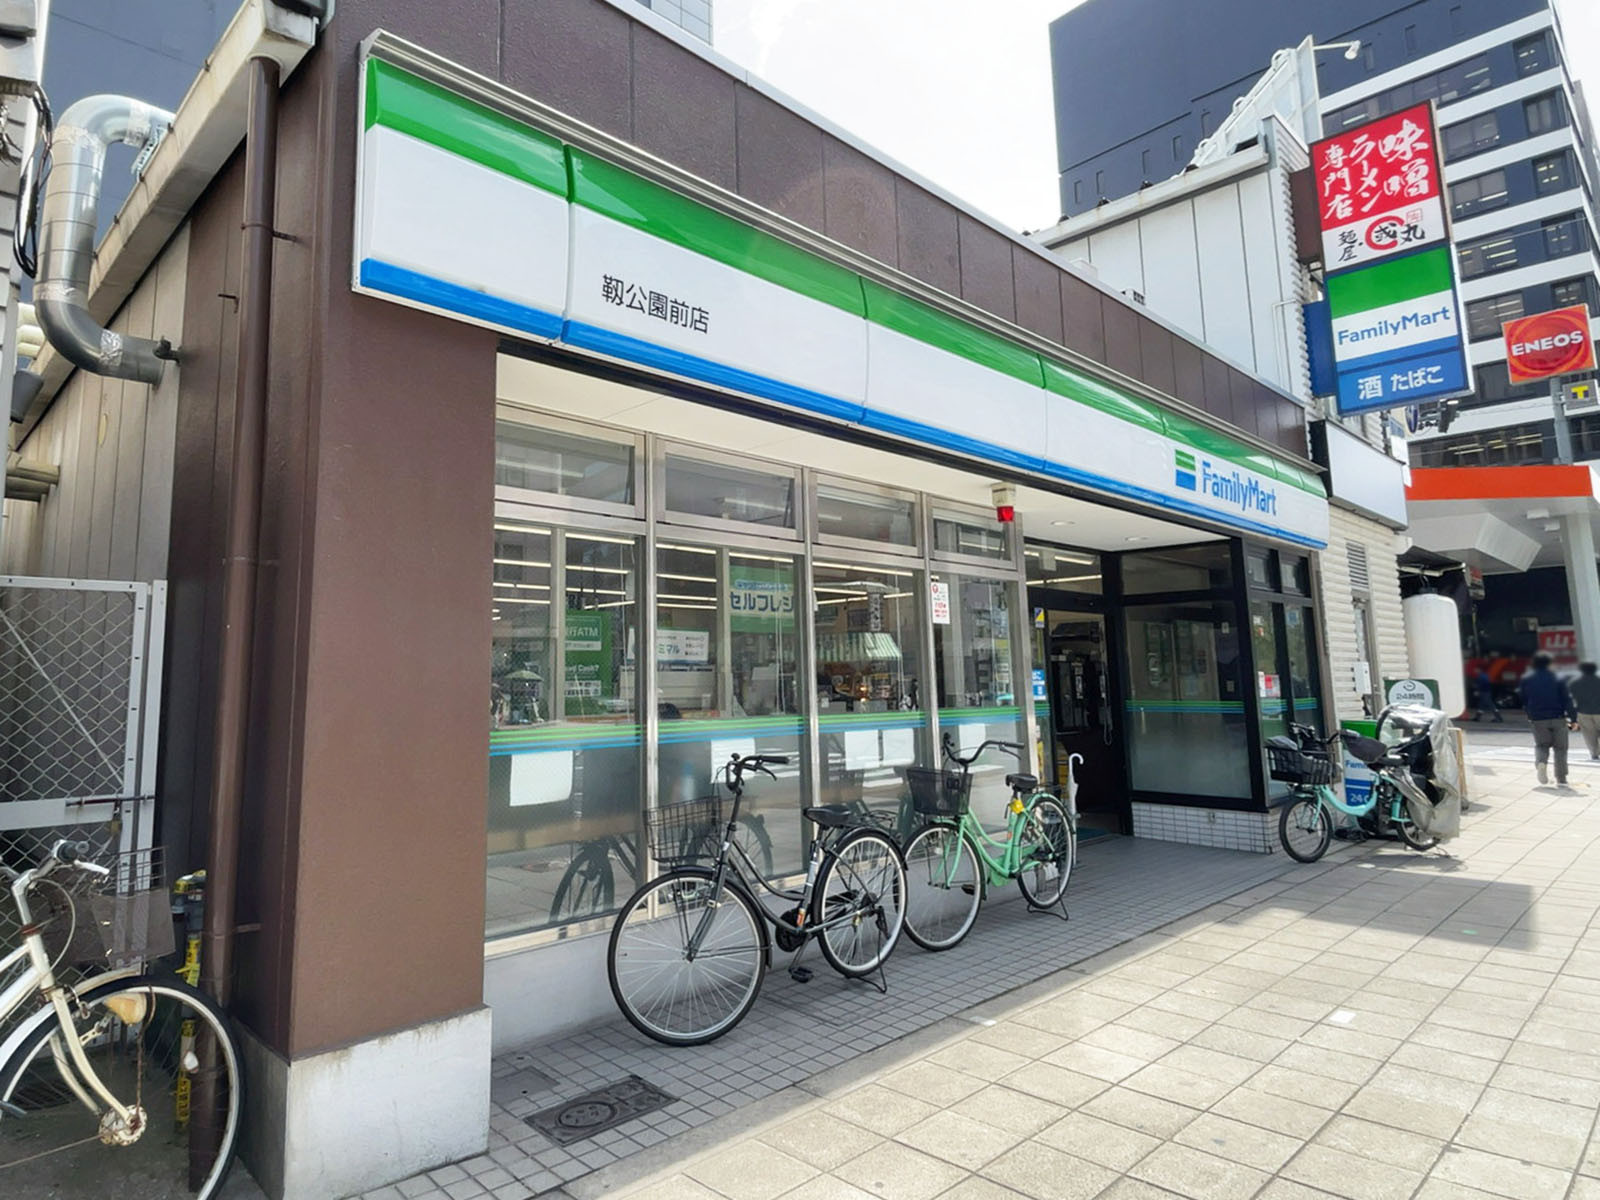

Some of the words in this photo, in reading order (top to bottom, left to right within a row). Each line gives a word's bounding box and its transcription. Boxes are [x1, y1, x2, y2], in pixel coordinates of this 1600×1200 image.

[1319, 144, 1354, 221] 専門店
[1349, 132, 1379, 214] ラーメン
[1378, 118, 1430, 199] 味噌
[1338, 305, 1450, 346] FamilyMart
[1511, 330, 1583, 357] ENEOS
[1357, 375, 1383, 400] 酒
[1390, 365, 1445, 391] たばこ
[1202, 459, 1277, 516] FamilyMart
[730, 591, 793, 613] セルフレジ
